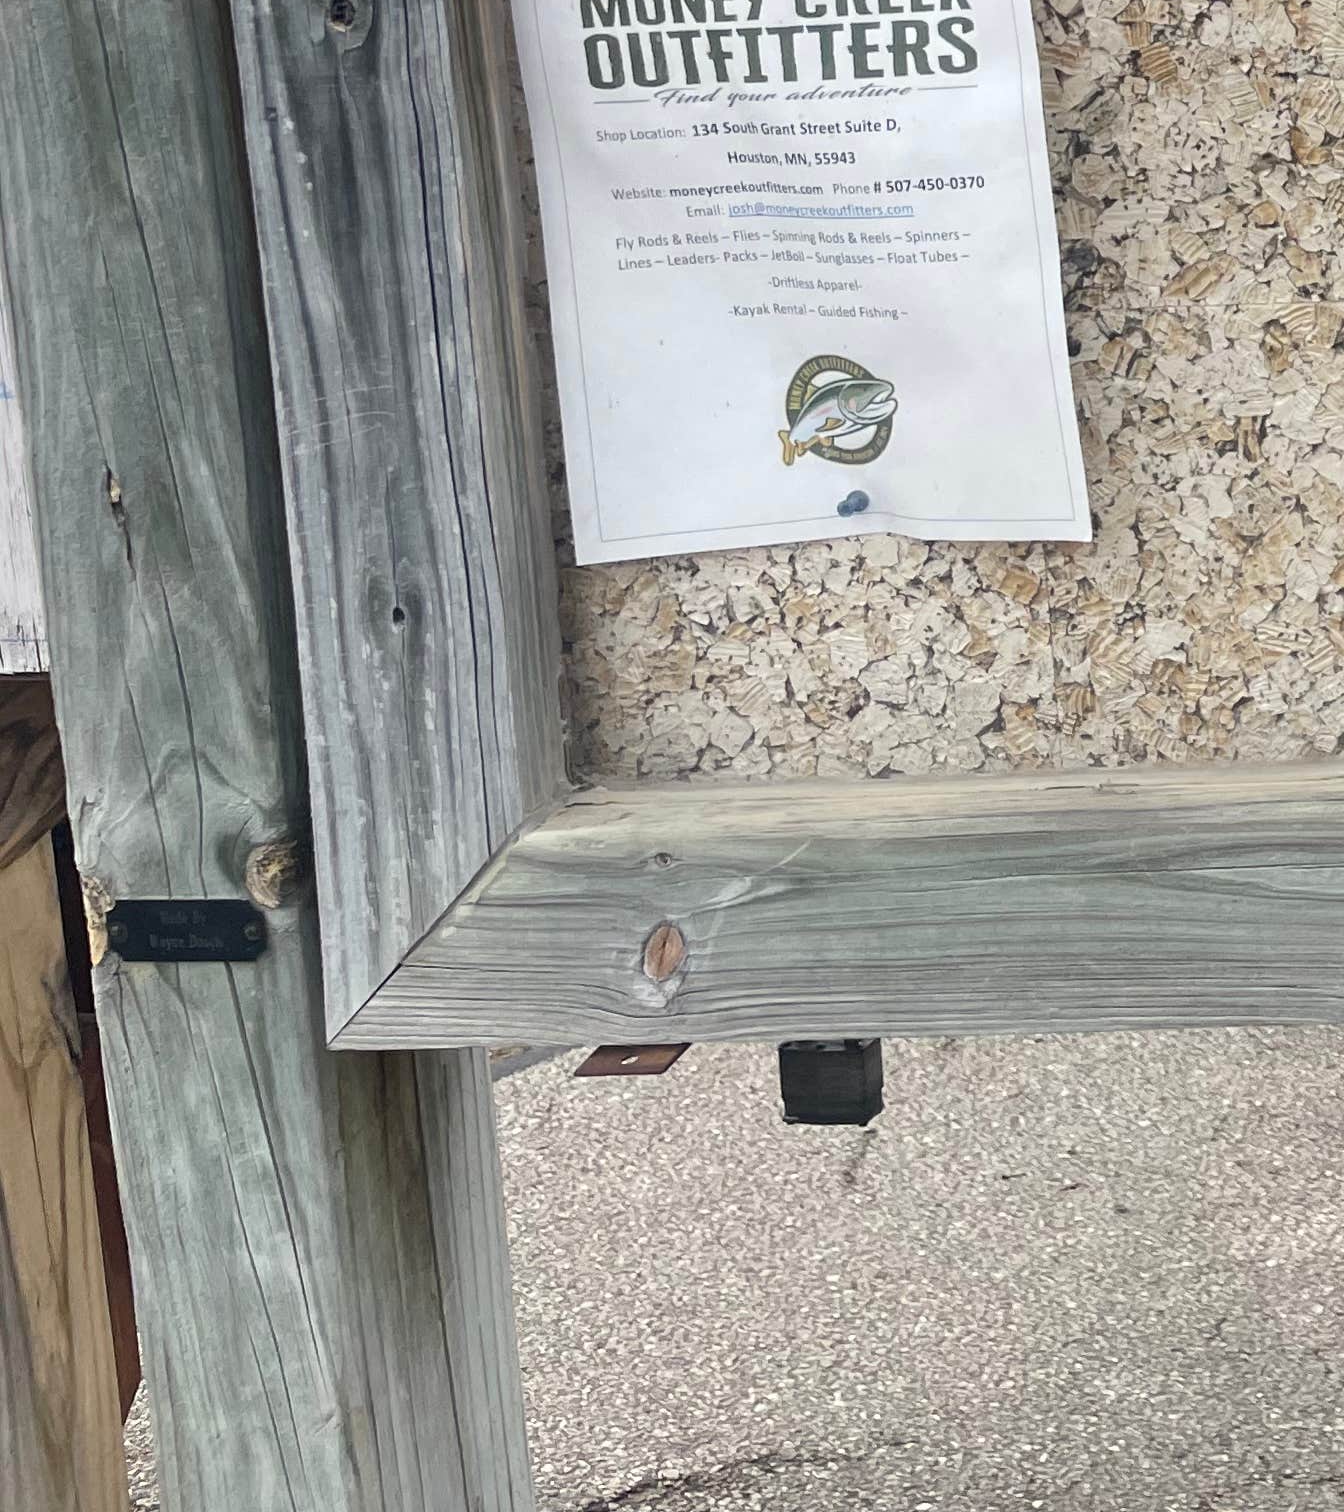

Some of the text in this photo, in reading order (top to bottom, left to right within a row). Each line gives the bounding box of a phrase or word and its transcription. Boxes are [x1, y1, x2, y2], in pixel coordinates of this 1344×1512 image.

[583, 15, 979, 90] OUTFITTERS
[653, 82, 914, 108] Find your adventure
[596, 118, 901, 144] Shop Location: 134 South Grant Street Suite D,
[726, 150, 857, 168] Houston, MN, 55943
[668, 179, 824, 199] moneycreekoutfitters.com
[831, 182, 871, 195] Phone
[873, 180, 882, 195] #
[885, 175, 985, 194] 507-450-0370
